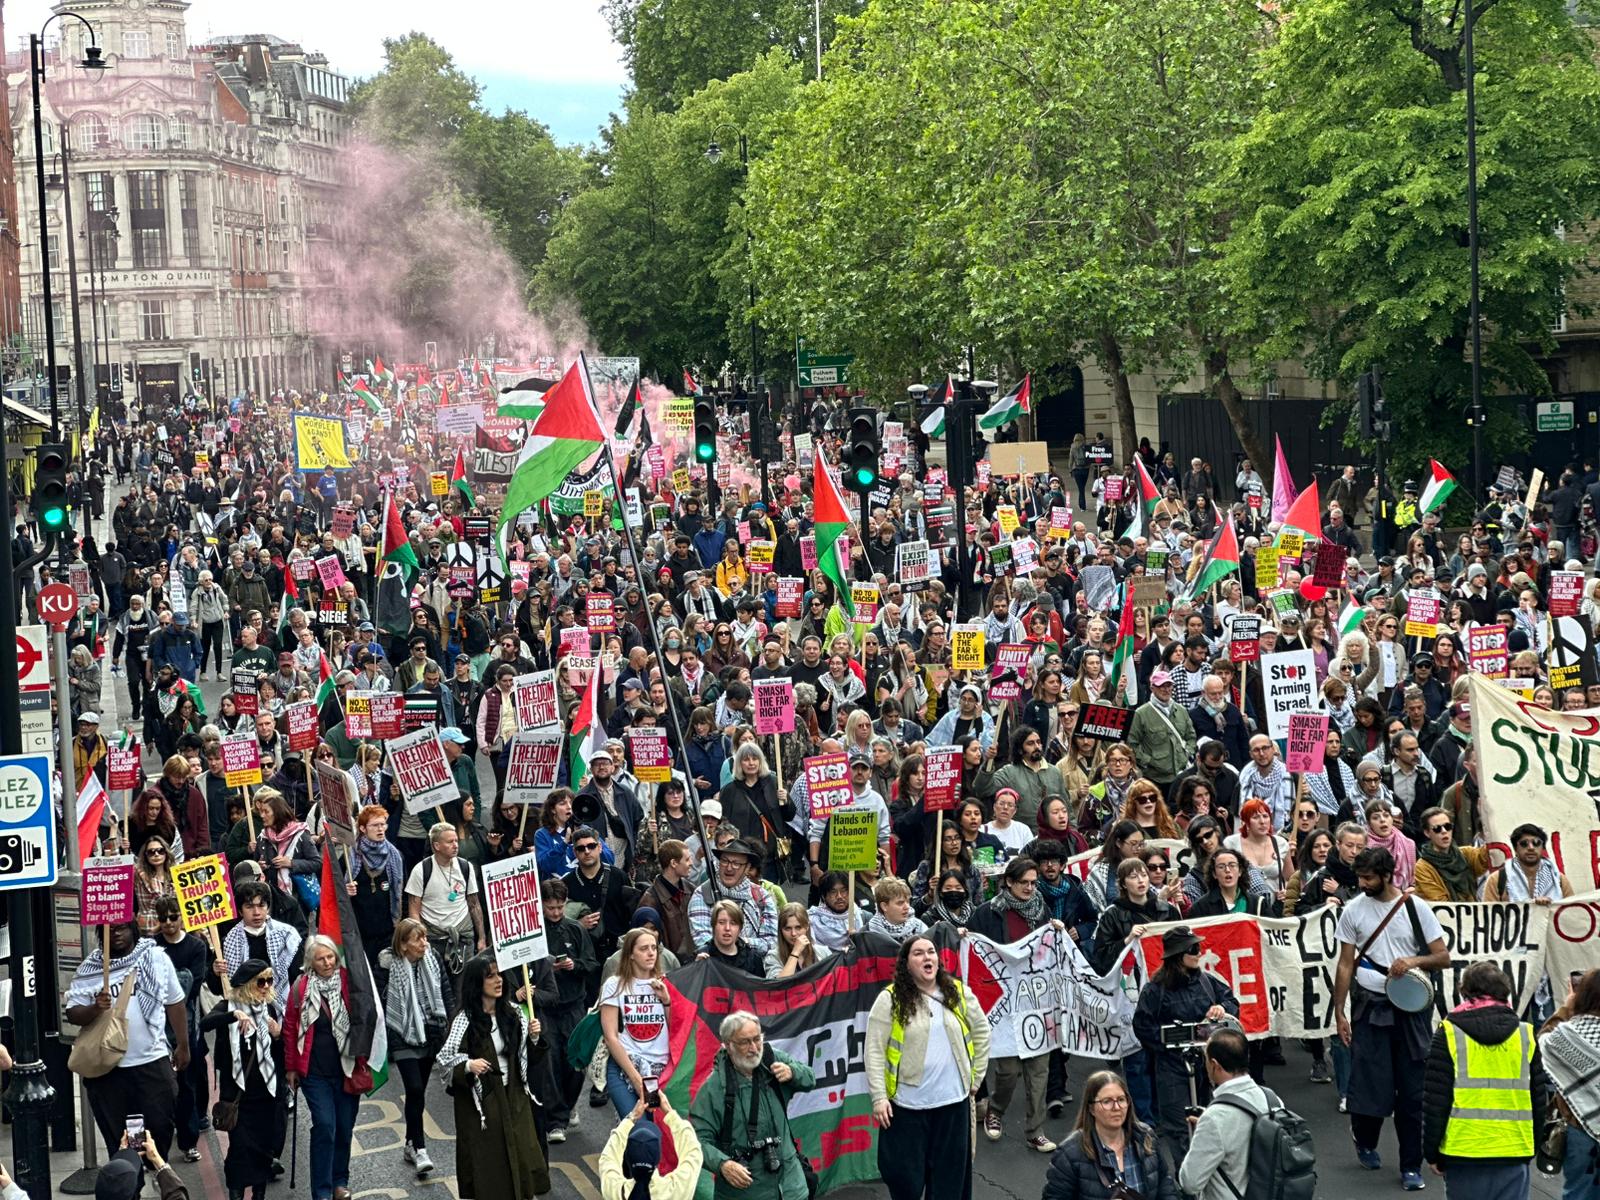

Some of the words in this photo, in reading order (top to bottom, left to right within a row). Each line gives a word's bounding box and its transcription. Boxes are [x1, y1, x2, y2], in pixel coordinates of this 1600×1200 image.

[901, 551, 928, 560] EXIST!
[901, 558, 928, 567] RESIST!
[41, 593, 73, 613] KU
[335, 602, 348, 612] THE
[587, 598, 613, 610] STOP
[1409, 603, 1437, 612] AGAINST
[1410, 598, 1434, 606] WOMEN
[319, 610, 348, 624] SIEGE
[1409, 609, 1422, 617] THE
[1409, 615, 1428, 623] RIGHT
[588, 615, 614, 627] STOP
[1234, 619, 1258, 629] FREEDOM
[957, 632, 977, 640] STOP
[1232, 631, 1259, 641] PALESTINE
[1472, 634, 1505, 650] STOP
[957, 654, 980, 662] RIGHT
[998, 650, 1030, 662] UNITY
[1473, 657, 1506, 673] STOP
[1550, 664, 1581, 676] PROTEST
[1270, 663, 1307, 681] Stop
[234, 674, 256, 685] FREEDOM
[1551, 674, 1566, 683] AND
[1551, 679, 1582, 689] SURVIVE
[517, 681, 556, 707] FREEDOM
[757, 686, 786, 697] SMASH
[991, 687, 1020, 697] RACISM
[1270, 682, 1311, 698] Arming
[759, 697, 774, 708] THE
[775, 696, 790, 706] FAR
[1274, 695, 1310, 713] Israel
[297, 707, 307, 715] NOT
[520, 700, 558, 727] PALESTINE
[759, 706, 784, 718] RIGHT
[1083, 704, 1129, 730] FREE
[22, 723, 44, 733] ington
[289, 720, 300, 729] ACT
[299, 716, 318, 726] AGAINST
[1291, 717, 1322, 730] SMASH
[1081, 724, 1123, 739] PALESTINE
[1291, 728, 1306, 742] THE
[1308, 729, 1325, 742] FAR
[34, 737, 47, 746] C1
[223, 742, 252, 752] WOMEN
[1290, 741, 1316, 754] RIGHT
[224, 748, 256, 759] AGAINST
[391, 738, 443, 773] FREEDOM
[511, 744, 560, 764] FREEDOM
[927, 755, 937, 764] IT'S
[937, 754, 948, 763] NOT
[948, 753, 952, 761] A
[226, 757, 241, 765] THE
[241, 755, 256, 764] FAR
[944, 762, 950, 770] TO
[226, 763, 249, 772] RIGHT
[807, 762, 848, 784] STOP
[400, 758, 450, 796] PALESTINE
[508, 763, 556, 785] PALESTINE
[927, 771, 936, 780] ACT
[936, 769, 959, 779] AGAINST
[810, 778, 850, 791] ISLAMOPHOBIA
[811, 787, 852, 809] STOP
[813, 807, 825, 816] THE
[833, 812, 859, 826] Hands
[861, 812, 875, 824] off
[832, 826, 868, 837] Lebanon
[832, 846, 845, 854] Stop
[86, 871, 129, 884] Refugees
[177, 864, 216, 888] STOP
[86, 884, 102, 893] are
[104, 882, 119, 892] not
[180, 879, 220, 900] TRUMP
[487, 870, 538, 911] FREEDOM
[86, 894, 97, 902] to
[98, 892, 126, 901] blame
[502, 899, 515, 907] FOR
[86, 902, 108, 912] Stop
[110, 900, 126, 910] the
[184, 892, 223, 916] STOP
[86, 913, 100, 922] far
[101, 910, 125, 923] right
[187, 906, 228, 928] FARAGE
[491, 899, 543, 942] PALESTINE
[1440, 902, 1539, 955] SCHOOL
[1264, 929, 1291, 947] THE
[627, 995, 642, 1004] WE
[1269, 986, 1287, 1012] OF
[635, 1005, 655, 1013] NOT
[625, 1014, 665, 1023] NUMBERS
[1021, 1008, 1062, 1051] OFF
[1062, 1010, 1122, 1055] CAMPUS
